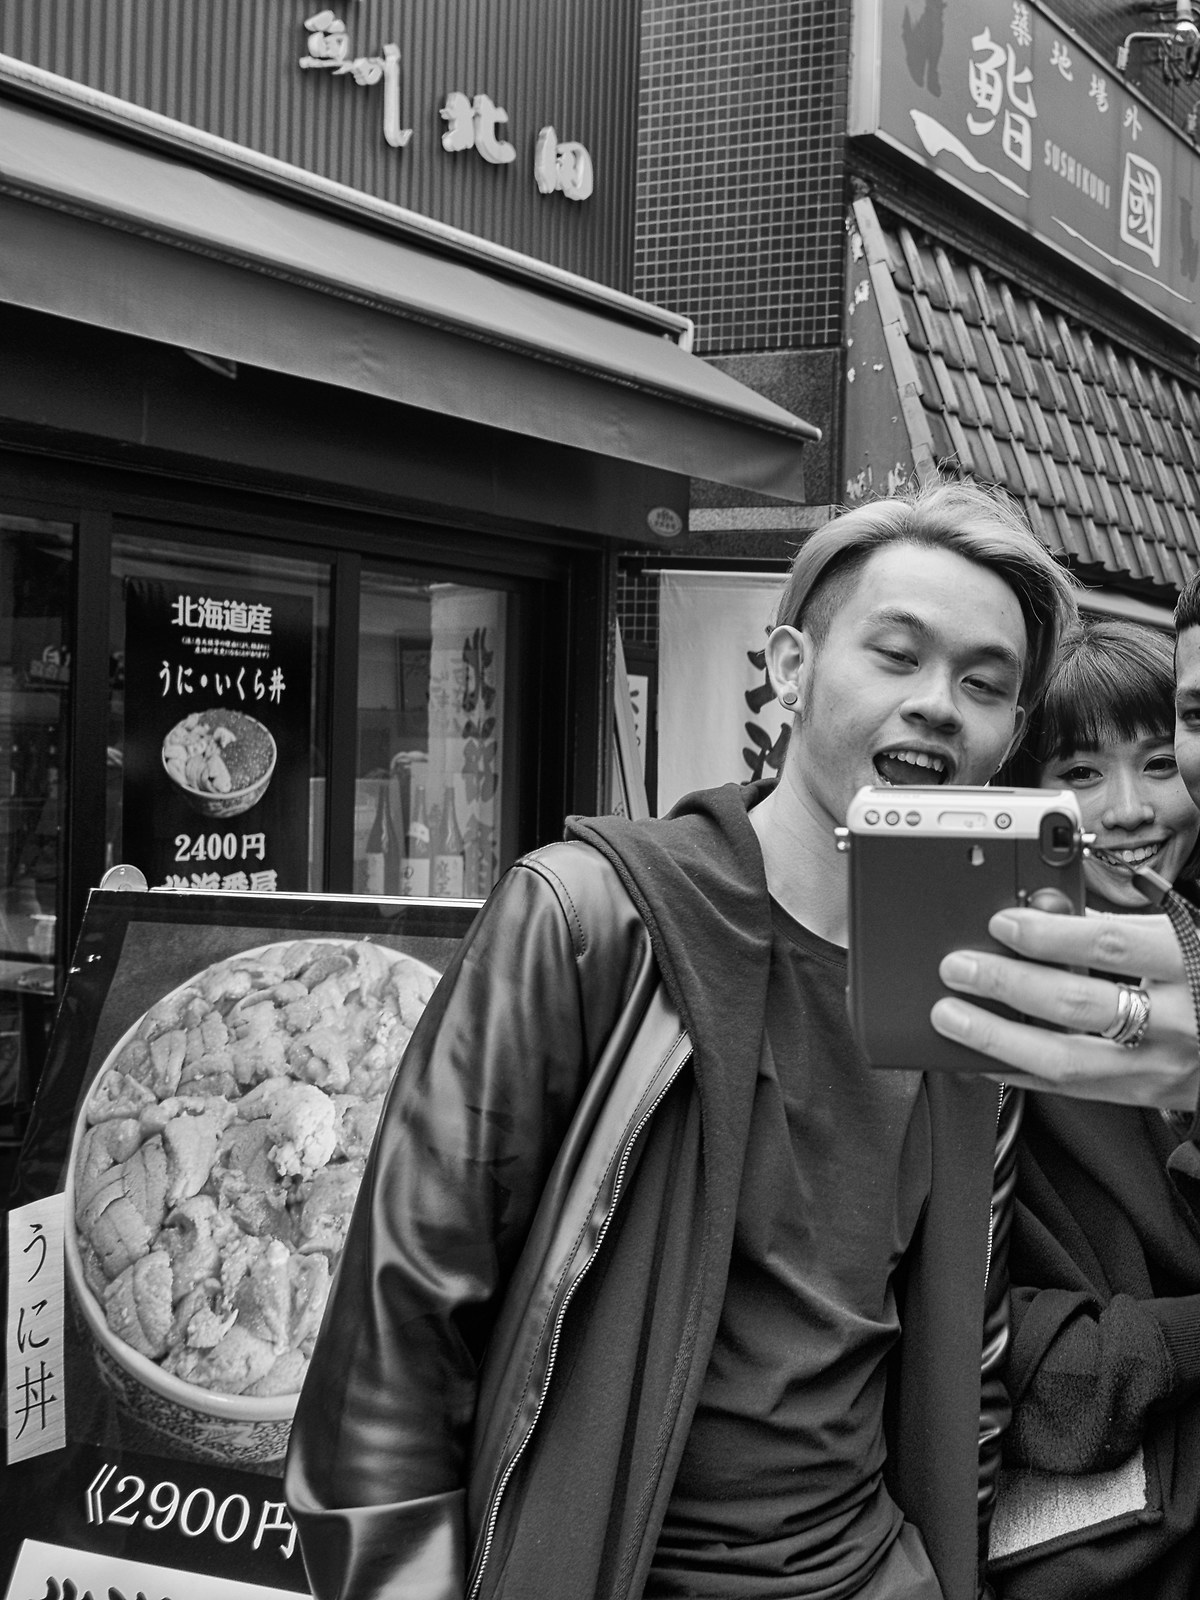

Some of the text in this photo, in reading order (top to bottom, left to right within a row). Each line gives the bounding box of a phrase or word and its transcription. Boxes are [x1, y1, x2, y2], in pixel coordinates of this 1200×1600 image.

[1009, 0, 1142, 141] 築地場外
[966, 26, 1162, 267] 鮨 國
[1044, 139, 1110, 209] SUSHIKUNI
[171, 595, 272, 635] 北海道産
[174, 832, 266, 862] 2400円
[14, 1223, 58, 1440] うに丼
